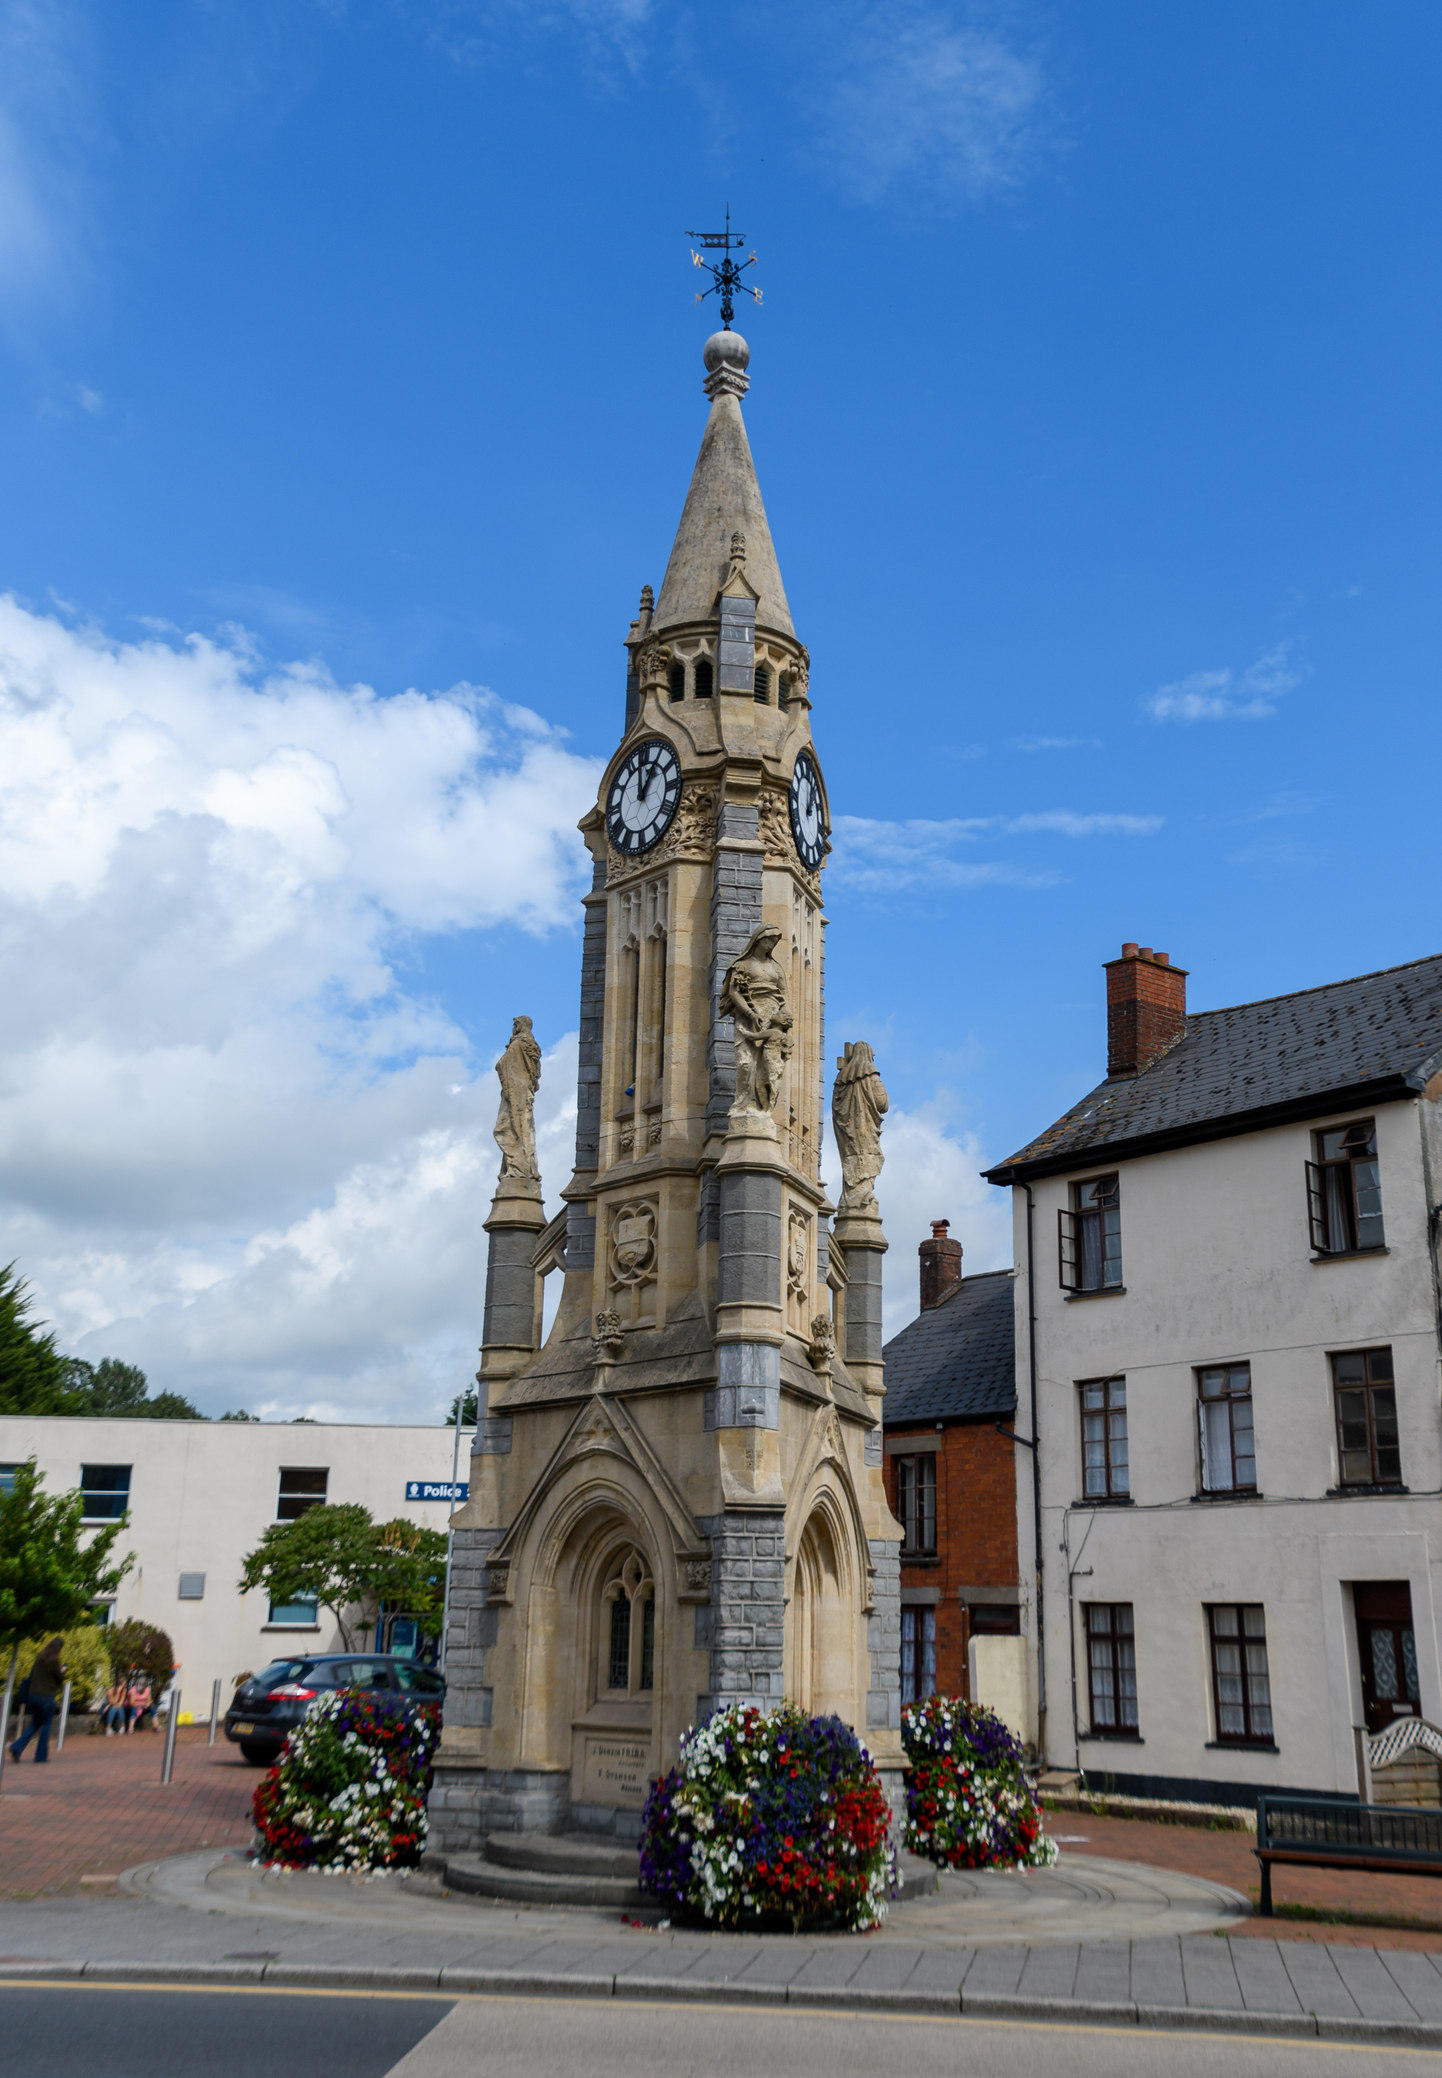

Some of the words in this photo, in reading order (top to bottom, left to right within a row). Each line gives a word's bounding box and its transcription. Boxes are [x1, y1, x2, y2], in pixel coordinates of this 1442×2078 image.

[690, 249, 704, 269] W
[749, 250, 758, 268] S
[695, 289, 705, 307] N
[753, 286, 764, 305] E
[423, 1484, 462, 1498] Police
